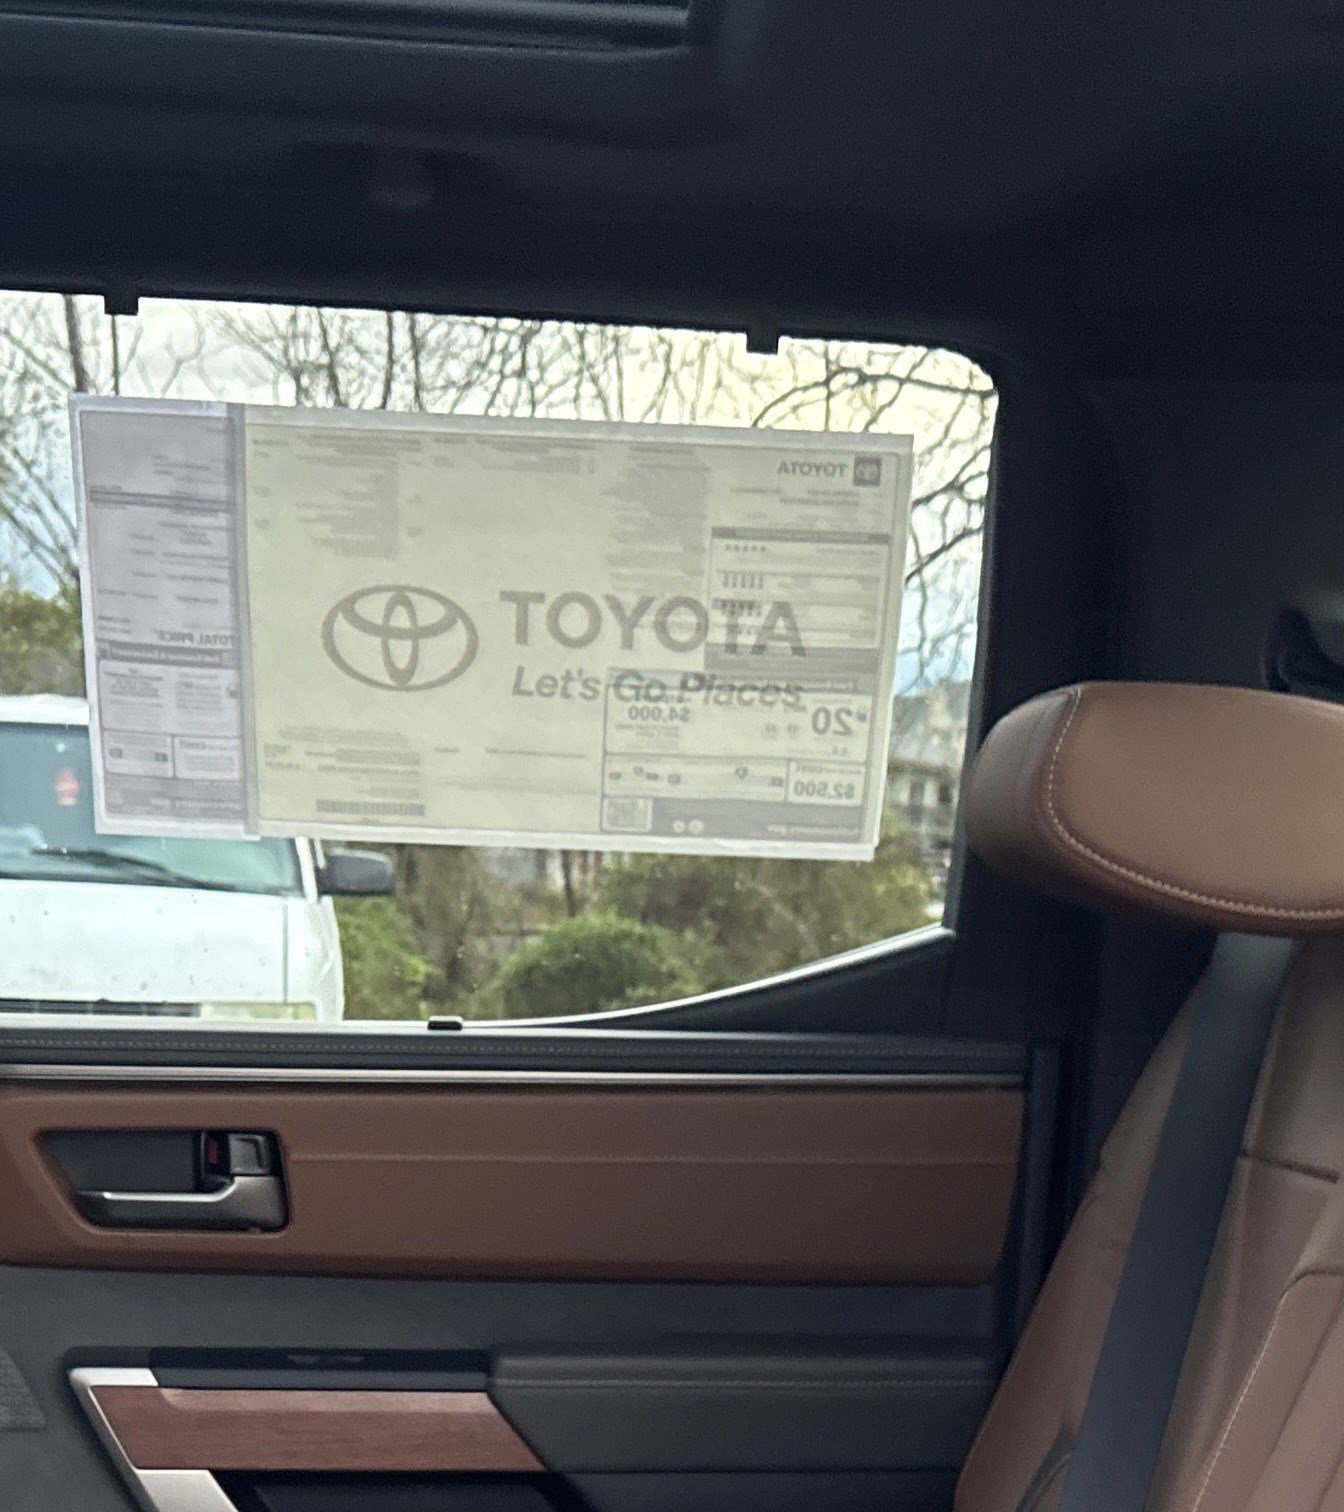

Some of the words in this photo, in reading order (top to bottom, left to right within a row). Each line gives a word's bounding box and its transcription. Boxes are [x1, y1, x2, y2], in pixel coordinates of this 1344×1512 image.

[500, 590, 807, 657] TOYOTA
[511, 664, 601, 701] Let's
[613, 668, 666, 702] Go
[677, 671, 804, 708] Places
